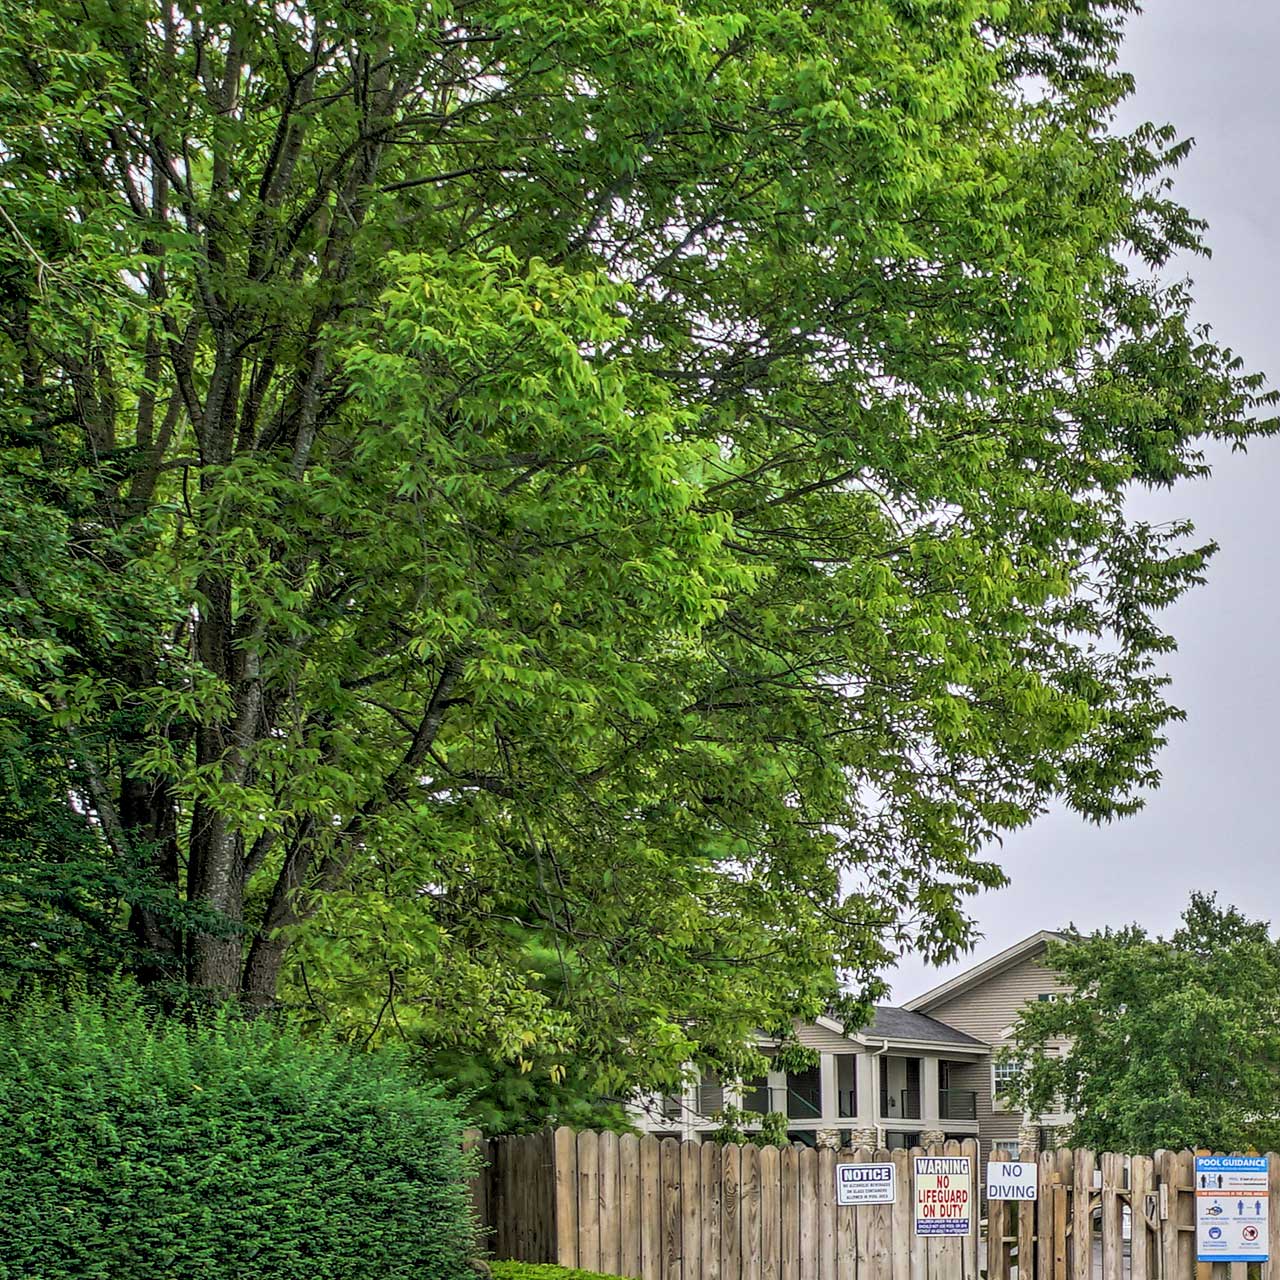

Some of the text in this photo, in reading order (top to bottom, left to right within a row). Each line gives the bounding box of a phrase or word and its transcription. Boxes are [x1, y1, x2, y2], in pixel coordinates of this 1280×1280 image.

[918, 1160, 968, 1174] WARNING
[1222, 1159, 1265, 1167] GUIDANCE
[844, 1169, 889, 1180] NOTICE
[1003, 1165, 1022, 1177] NO
[937, 1175, 949, 1188] NO
[918, 1190, 968, 1203] LIFEGUARD
[990, 1185, 1035, 1198] DIVING
[923, 1204, 963, 1217] ON DUTY
